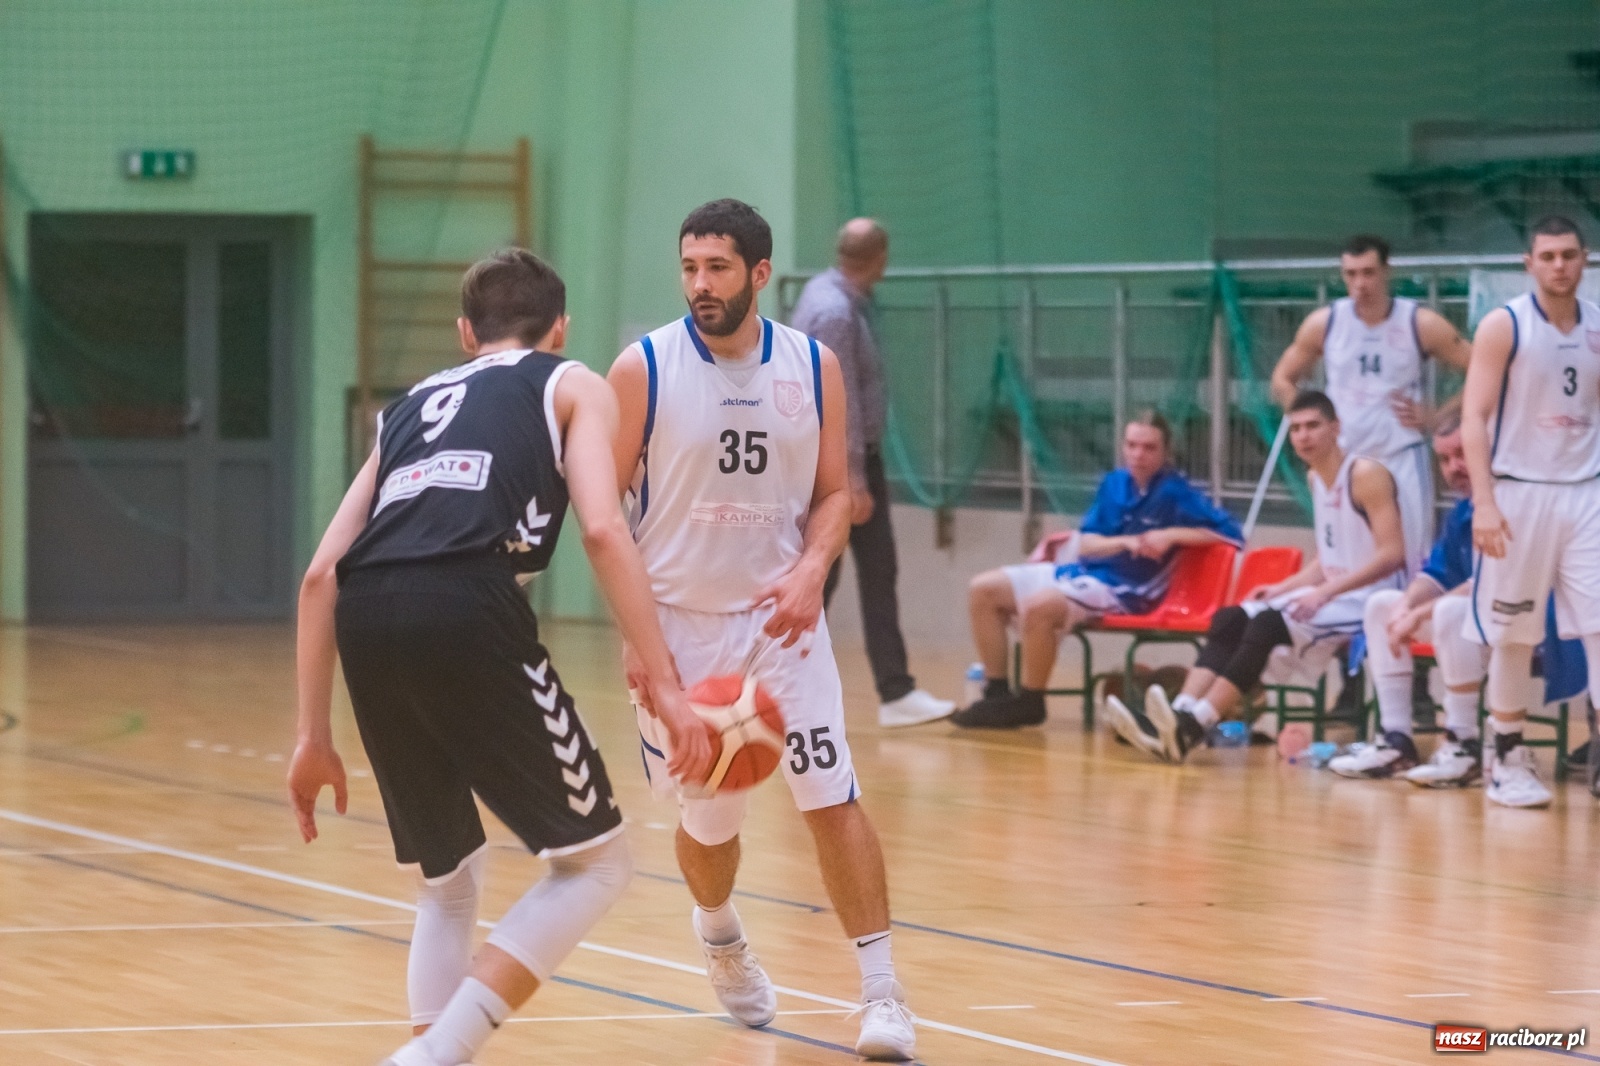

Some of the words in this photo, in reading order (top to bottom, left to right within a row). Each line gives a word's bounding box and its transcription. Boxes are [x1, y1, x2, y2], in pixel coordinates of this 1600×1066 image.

[1359, 353, 1381, 376] 14
[1563, 366, 1577, 397] 3
[421, 382, 467, 443] 9
[718, 429, 768, 475] 35
[786, 726, 837, 775] 35
